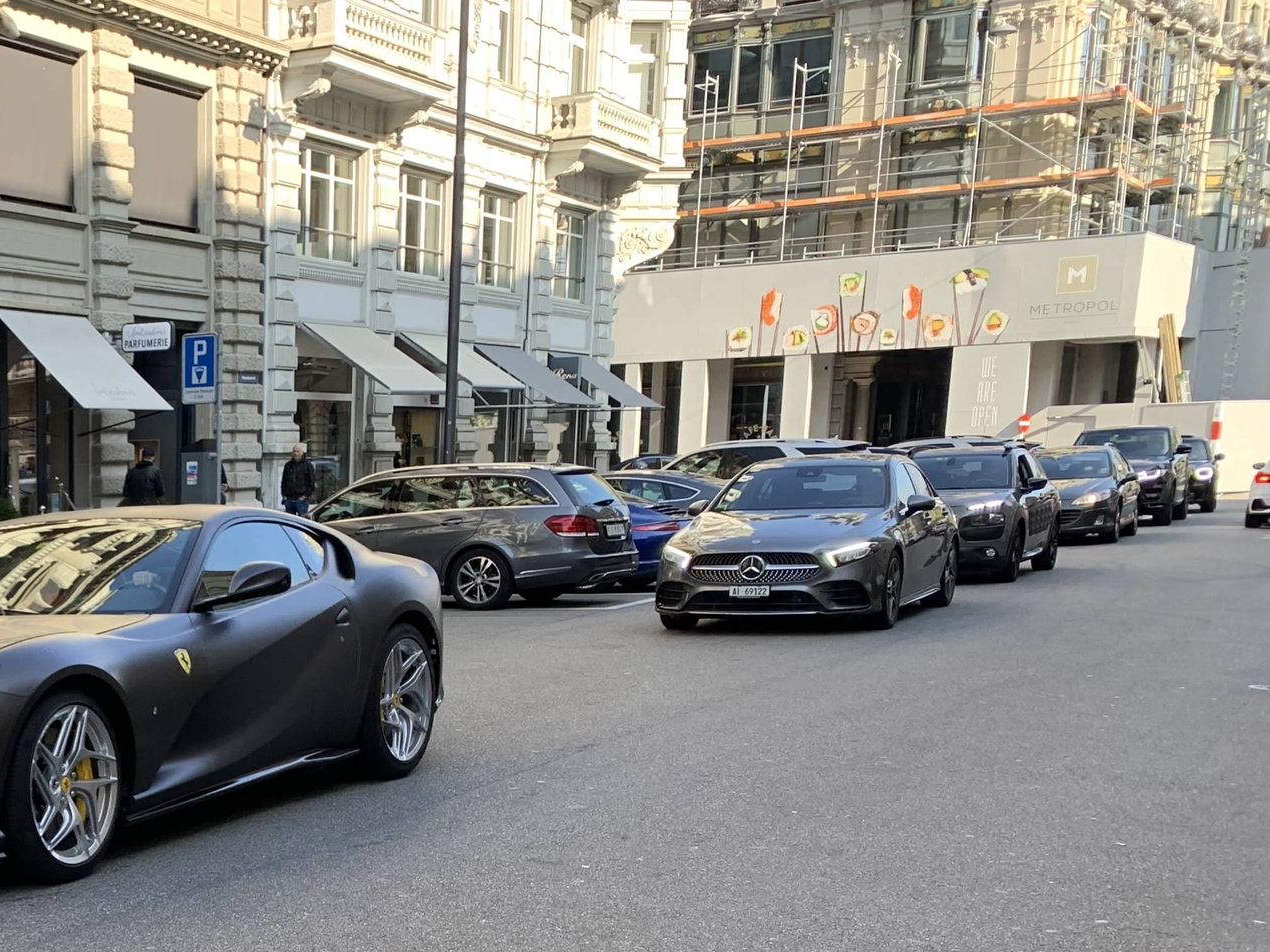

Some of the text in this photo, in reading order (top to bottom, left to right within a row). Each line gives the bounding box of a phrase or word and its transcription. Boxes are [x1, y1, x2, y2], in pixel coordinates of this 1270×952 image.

[1030, 300, 1118, 316] METROPOL
[124, 338, 168, 348] PARFUMERIE
[193, 340, 207, 365] P
[981, 356, 998, 377] WE
[976, 381, 997, 402] ARE
[971, 405, 998, 427] OPEN
